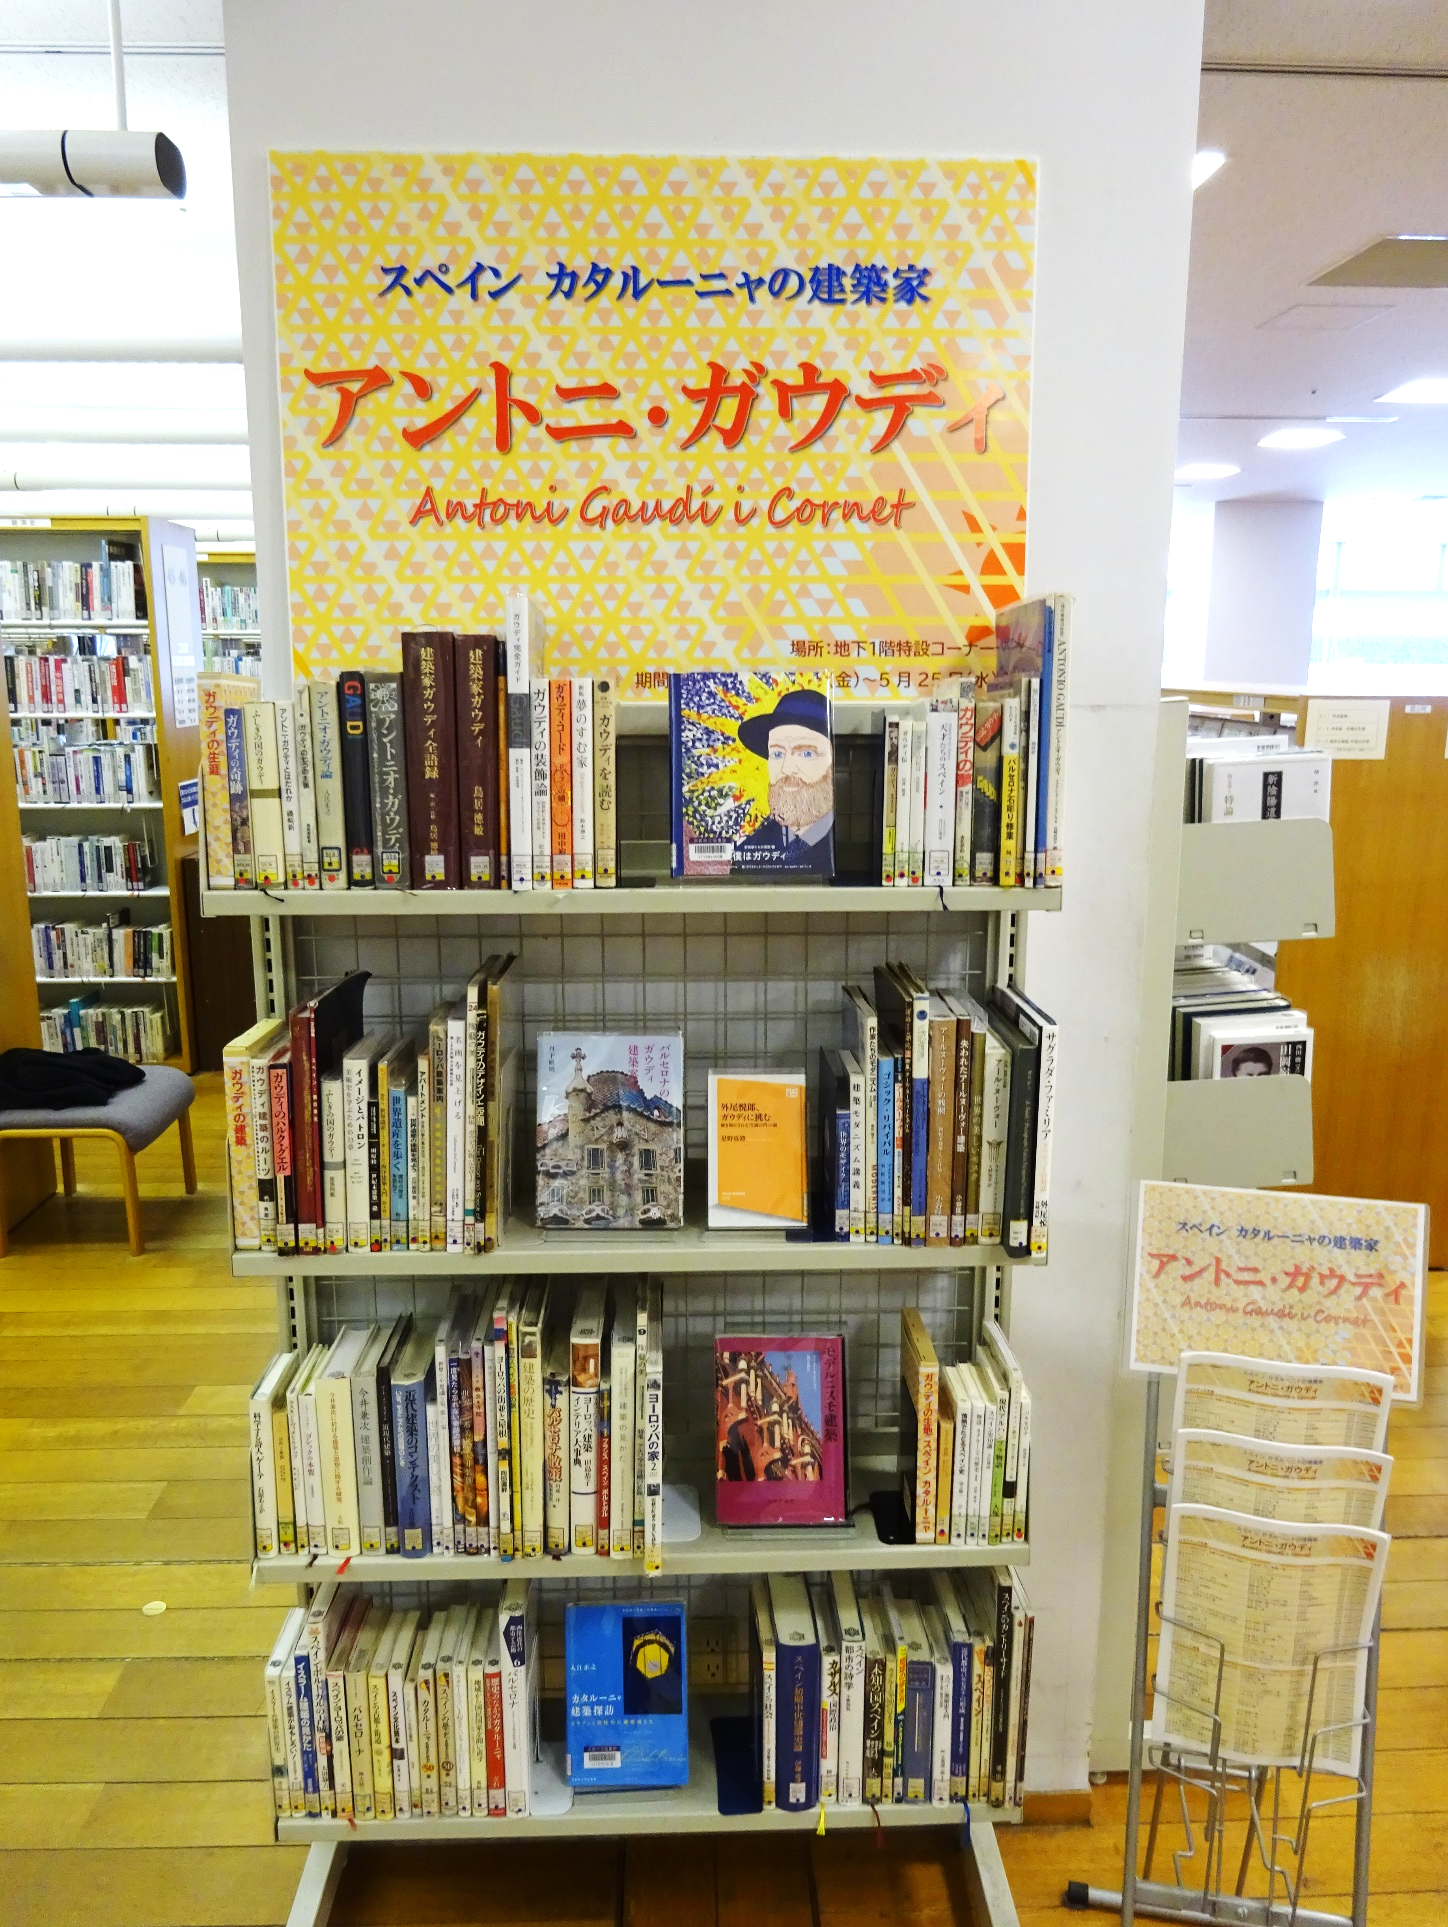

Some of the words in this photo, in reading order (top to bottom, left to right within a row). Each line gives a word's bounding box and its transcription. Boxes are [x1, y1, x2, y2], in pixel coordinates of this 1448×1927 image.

[378, 262, 521, 299] スペイン
[546, 262, 932, 306] カタルーニャの建築家
[304, 360, 1007, 455] アントニ・ガウディ
[409, 485, 567, 529] Antoni
[580, 485, 723, 528] Gaudí
[733, 486, 759, 525] i
[767, 487, 914, 529] Cornet
[635, 672, 669, 689] 期間
[1057, 638, 1067, 692] ANTONIO
[420, 647, 439, 780] 建築家ガウディ全語録
[469, 649, 484, 748] 建築家ガウディ
[203, 691, 221, 776] ガウディの生涯
[226, 714, 244, 794] ガウディの奇跡
[533, 688, 549, 798] ガウディの装飾論
[576, 698, 588, 769] 夢のすむ家
[379, 714, 401, 852] アントニオ・ガウディ
[598, 714, 612, 811] ガウディを読む
[732, 850, 787, 862] 僕はガウディ
[644, 1044, 655, 1083] ガウディ
[659, 1045, 670, 1098] バルセロナの
[1041, 1032, 1057, 1140] サグラダ・ファミリア
[231, 1068, 247, 1147] ガウディの建築
[255, 1065, 271, 1177] ガウディ建築のルーツ
[355, 1069, 366, 1150] イメージとパトロン
[721, 1113, 771, 1122] ガウディに挑む
[882, 1071, 892, 1156] ゴシック・リバイバル
[1176, 1220, 1227, 1236] スペイン
[1235, 1225, 1381, 1253] カタルーニャの建築家
[1147, 1251, 1407, 1305] アントニ・ガウディ
[1181, 1294, 1239, 1314] Antoni
[522, 1363, 535, 1420] 建築の歴史
[922, 1371, 934, 1438] ガウディの生地
[1247, 1379, 1318, 1395] アントニ・ガウディ
[404, 1389, 421, 1504] 近代建築のコンテクスト
[547, 1408, 562, 1482] バルセロナ散策
[573, 1396, 583, 1467] インテリア大事典
[582, 1396, 593, 1453] ヨーロッパ建築
[648, 1393, 660, 1461] ヨーロッパの家
[920, 1438, 933, 1476] スペイン
[919, 1479, 932, 1535] カタルーニャ
[856, 1645, 864, 1676] スペイン
[508, 1672, 518, 1709] バルセロナ
[571, 1694, 622, 1704] カタルーニャ
[571, 1705, 614, 1717] 建築探訪
[869, 1663, 883, 1738] 未知の国スペイン
[353, 1707, 363, 1756] バルセローナ
